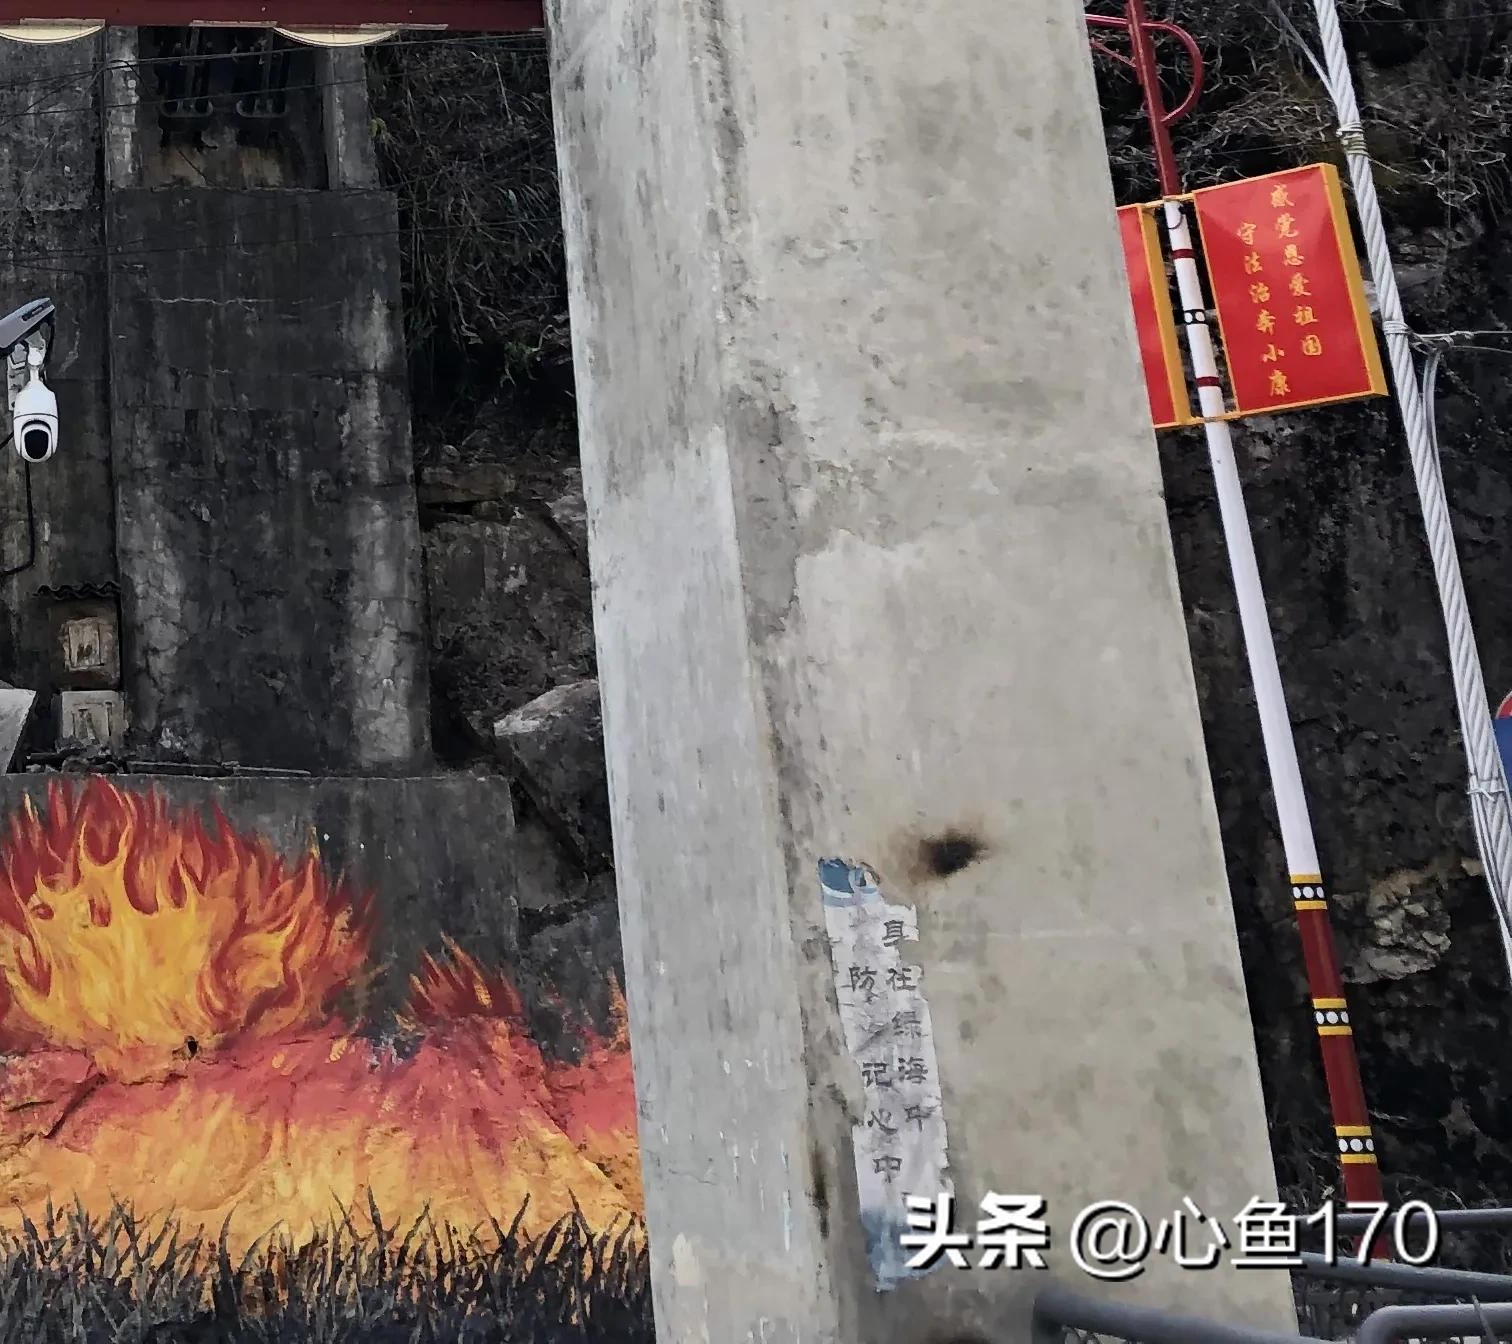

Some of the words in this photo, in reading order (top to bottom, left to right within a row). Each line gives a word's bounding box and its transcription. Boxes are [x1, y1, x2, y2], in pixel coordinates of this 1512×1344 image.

[1237, 222, 1291, 396] 守法治奔小康
[1270, 184, 1322, 356] 感党恩爱祖国
[848, 964, 902, 1184] 防记心中
